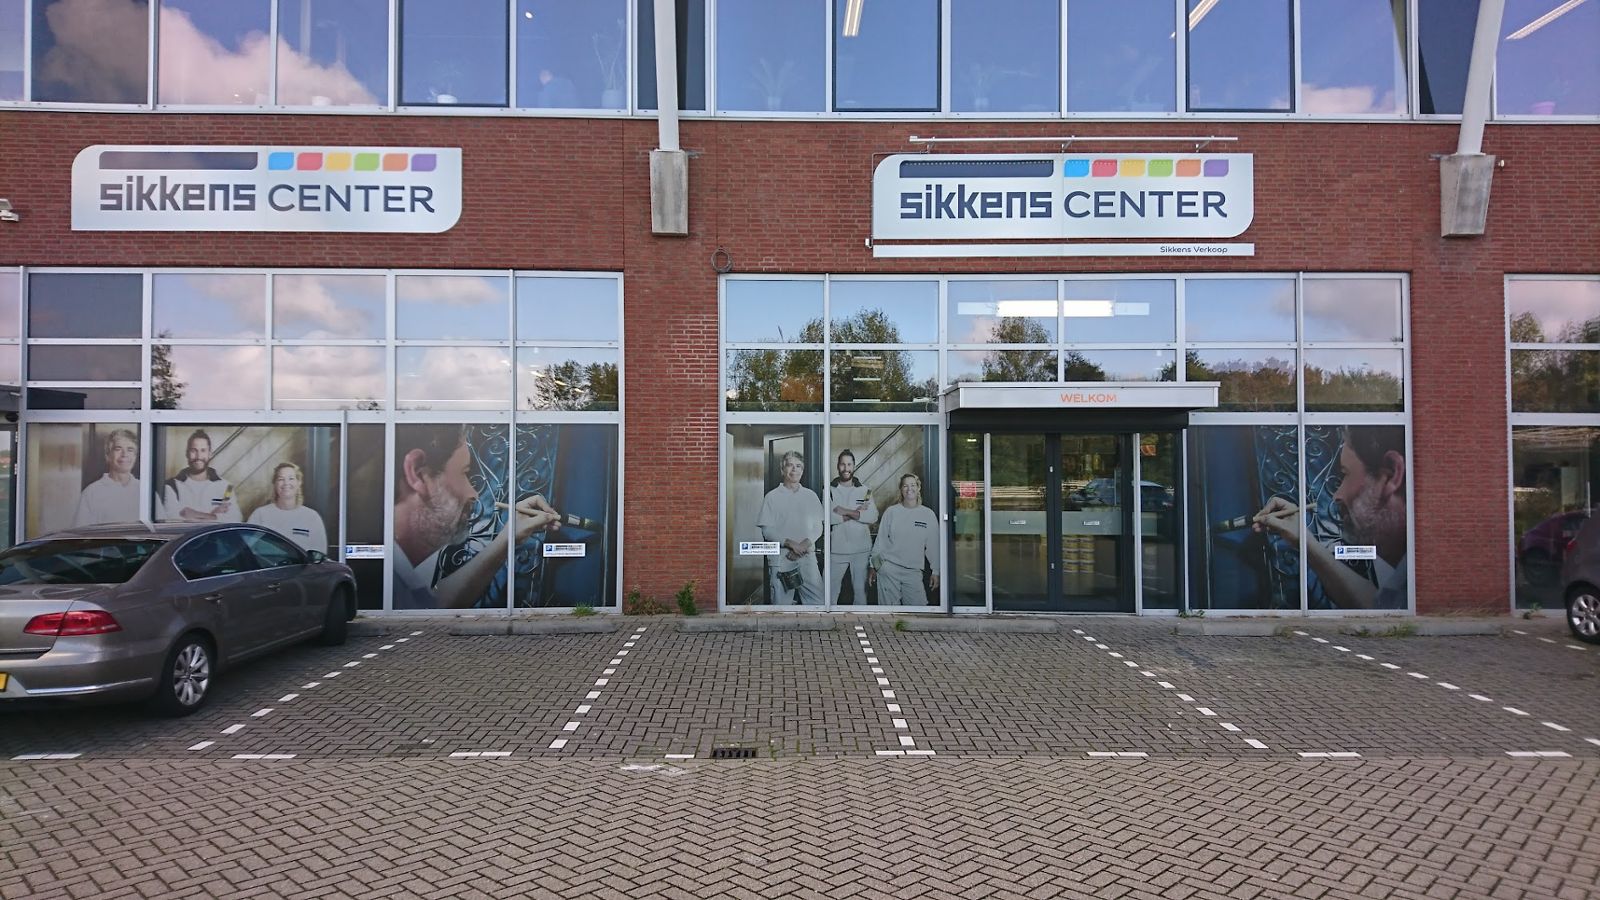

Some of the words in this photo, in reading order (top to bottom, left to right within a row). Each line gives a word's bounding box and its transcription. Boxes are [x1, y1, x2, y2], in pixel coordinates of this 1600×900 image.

[100, 175, 256, 211] sikkens
[268, 184, 435, 213] CENTER
[900, 183, 1053, 219] sikkens
[1064, 190, 1228, 219] CENTER
[1194, 246, 1228, 254] Verkoop
[1060, 393, 1117, 403] WELKOM
